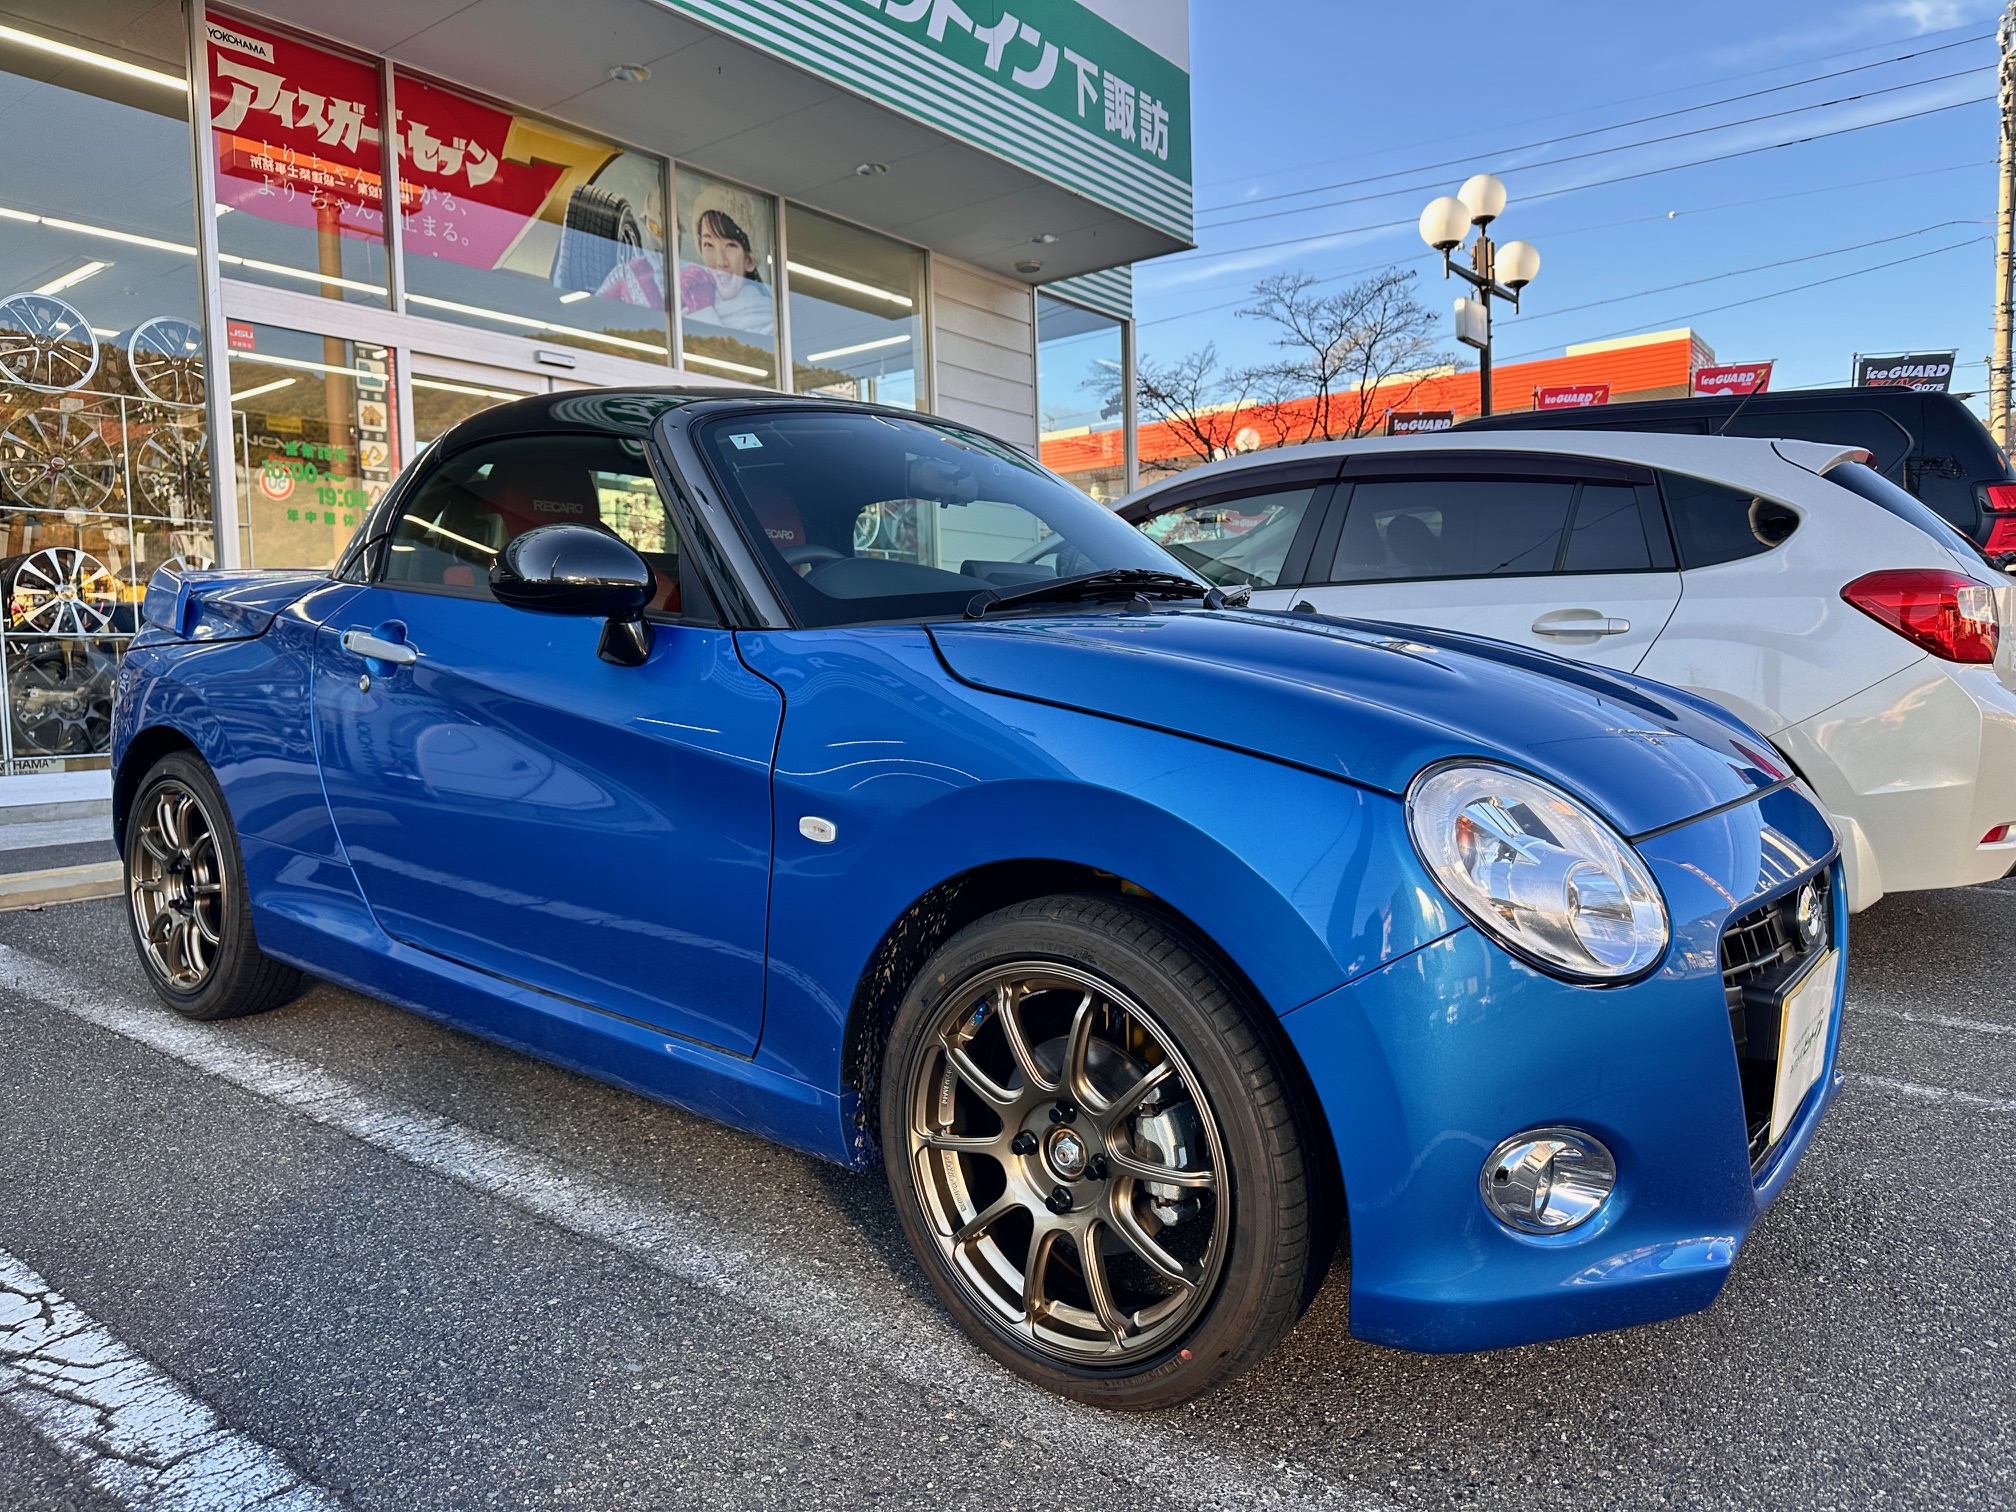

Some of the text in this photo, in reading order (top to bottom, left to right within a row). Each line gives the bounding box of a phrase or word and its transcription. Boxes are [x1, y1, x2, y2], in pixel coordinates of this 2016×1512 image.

[207, 27, 267, 57] YOKOHAMA
[229, 329, 254, 339] JSU
[315, 487, 369, 510] 19:00
[533, 499, 584, 514] RECARO
[287, 509, 356, 527] 年中無休
